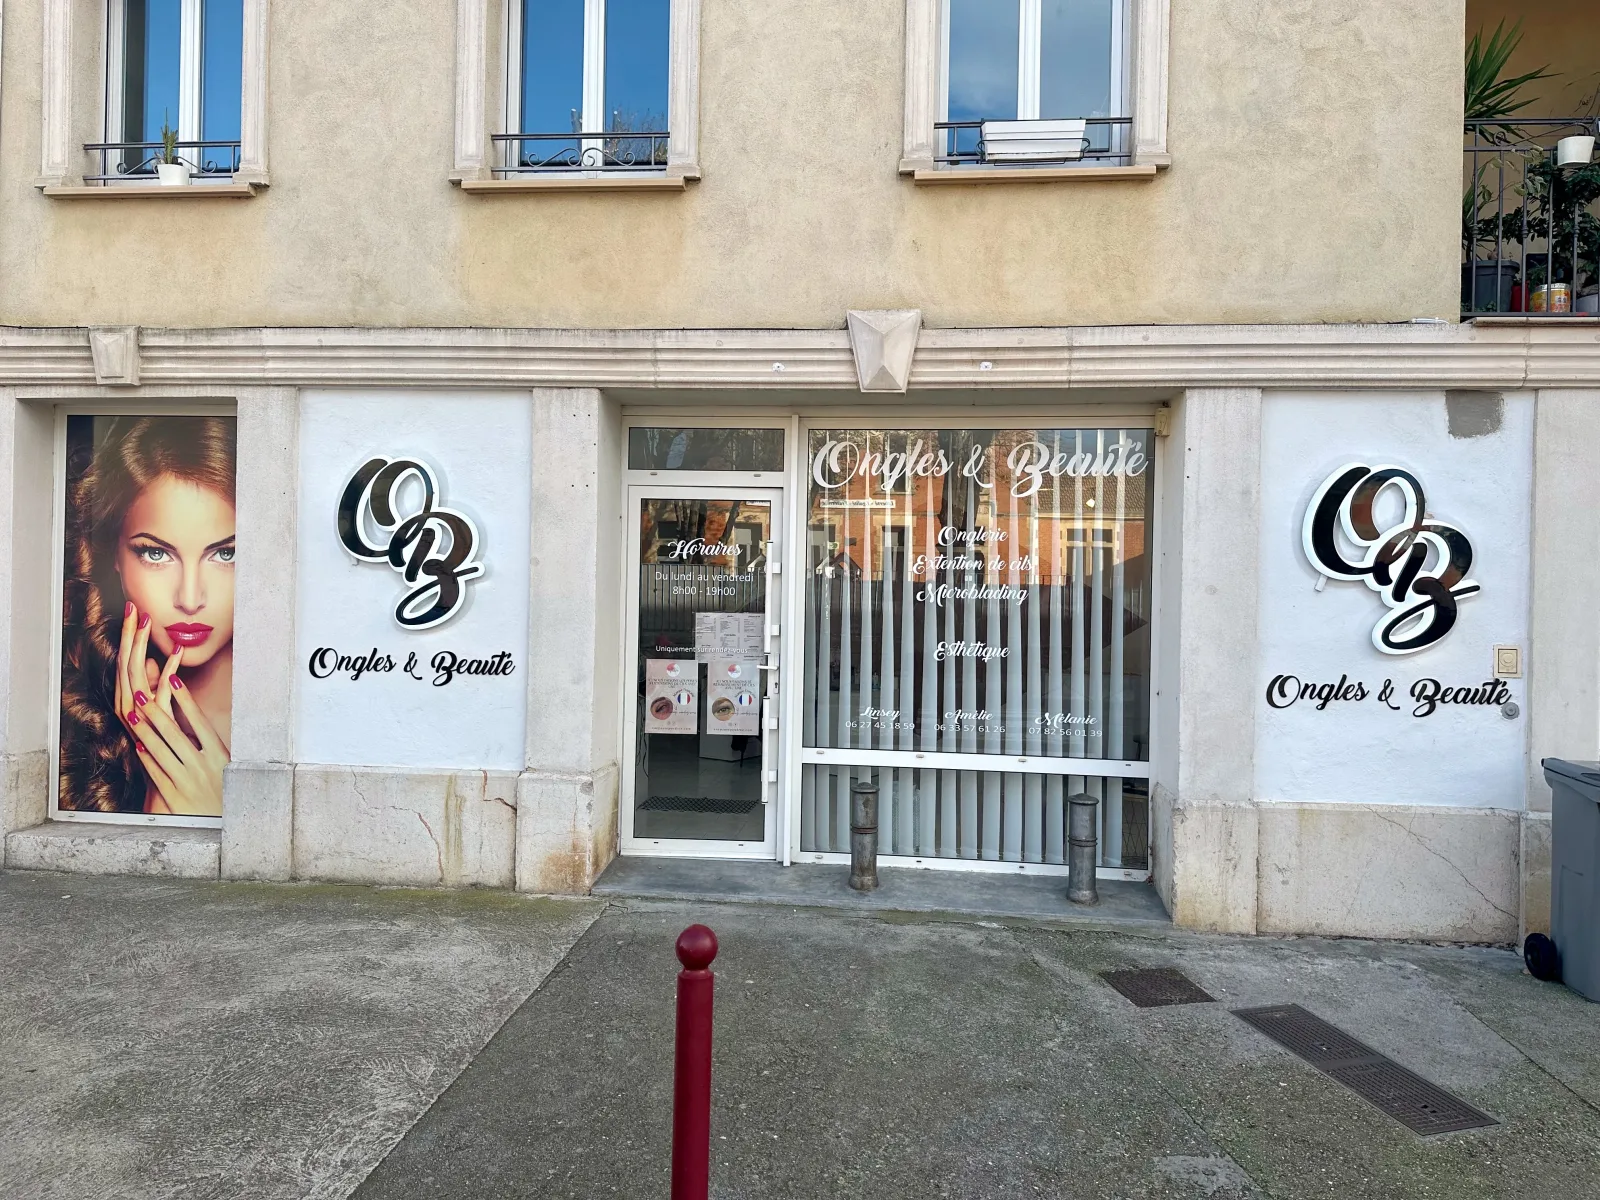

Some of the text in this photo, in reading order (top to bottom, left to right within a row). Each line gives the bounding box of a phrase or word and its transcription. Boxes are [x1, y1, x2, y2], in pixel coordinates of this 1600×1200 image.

[812, 437, 1150, 498] Ongles & Beauté
[937, 525, 1009, 551] Onglerie
[667, 537, 744, 560] Horaires
[913, 553, 1034, 575] Extention de cils
[655, 571, 754, 582] Du lundi au vendredi
[672, 586, 697, 595] 8h00
[706, 586, 736, 596] 19h00
[916, 583, 1029, 607] Microblading
[655, 645, 696, 653] Uniquement
[933, 640, 1011, 663] Esthétique
[308, 647, 516, 687] Ongles & Beauté
[1266, 673, 1513, 718] Ongles & Beauté
[860, 706, 901, 721] Linsey
[944, 708, 995, 725] Amélie
[1034, 711, 1098, 729] Mélanie
[845, 720, 857, 728] 06
[874, 721, 886, 729] 45
[903, 722, 915, 730] 59
[933, 723, 946, 731] 06
[963, 724, 976, 732] 57
[993, 725, 1006, 733] 26
[1028, 727, 1103, 737] 07 82 56 01 39
